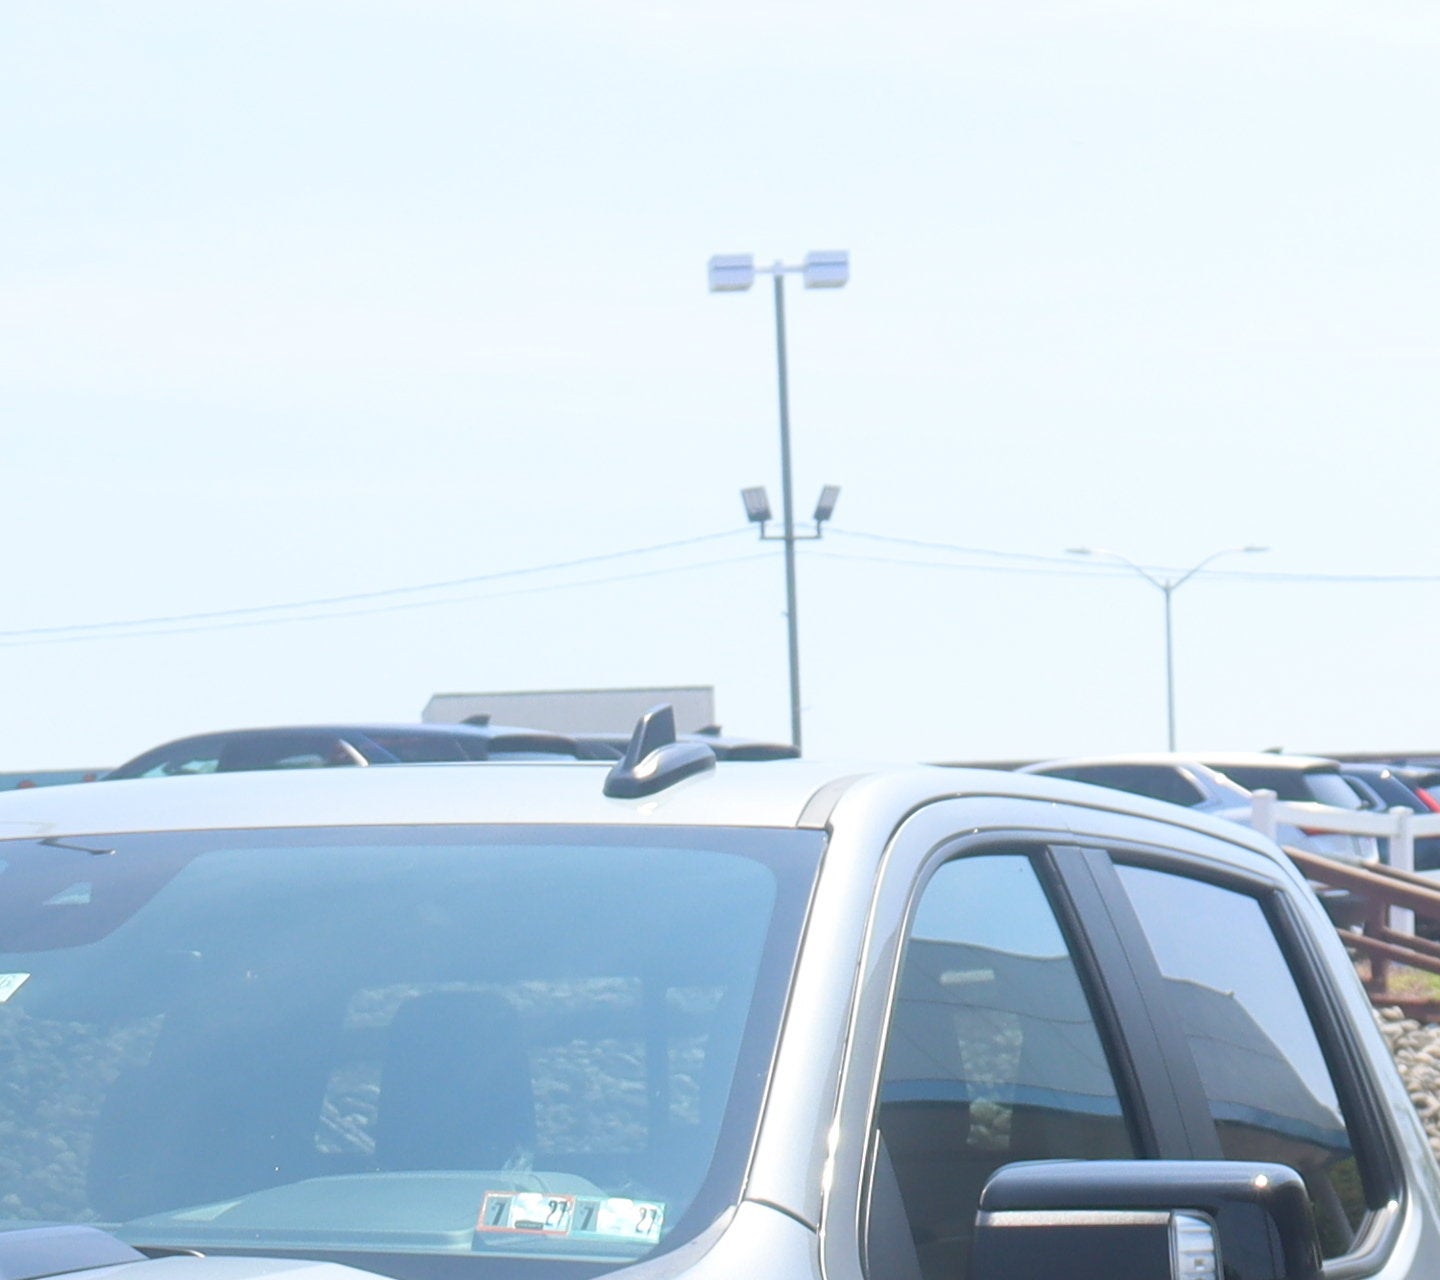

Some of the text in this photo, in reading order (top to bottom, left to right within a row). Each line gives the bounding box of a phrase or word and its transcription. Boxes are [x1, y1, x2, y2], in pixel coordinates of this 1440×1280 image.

[489, 1200, 568, 1229] 7 27
[580, 1206, 659, 1236] 7 27
